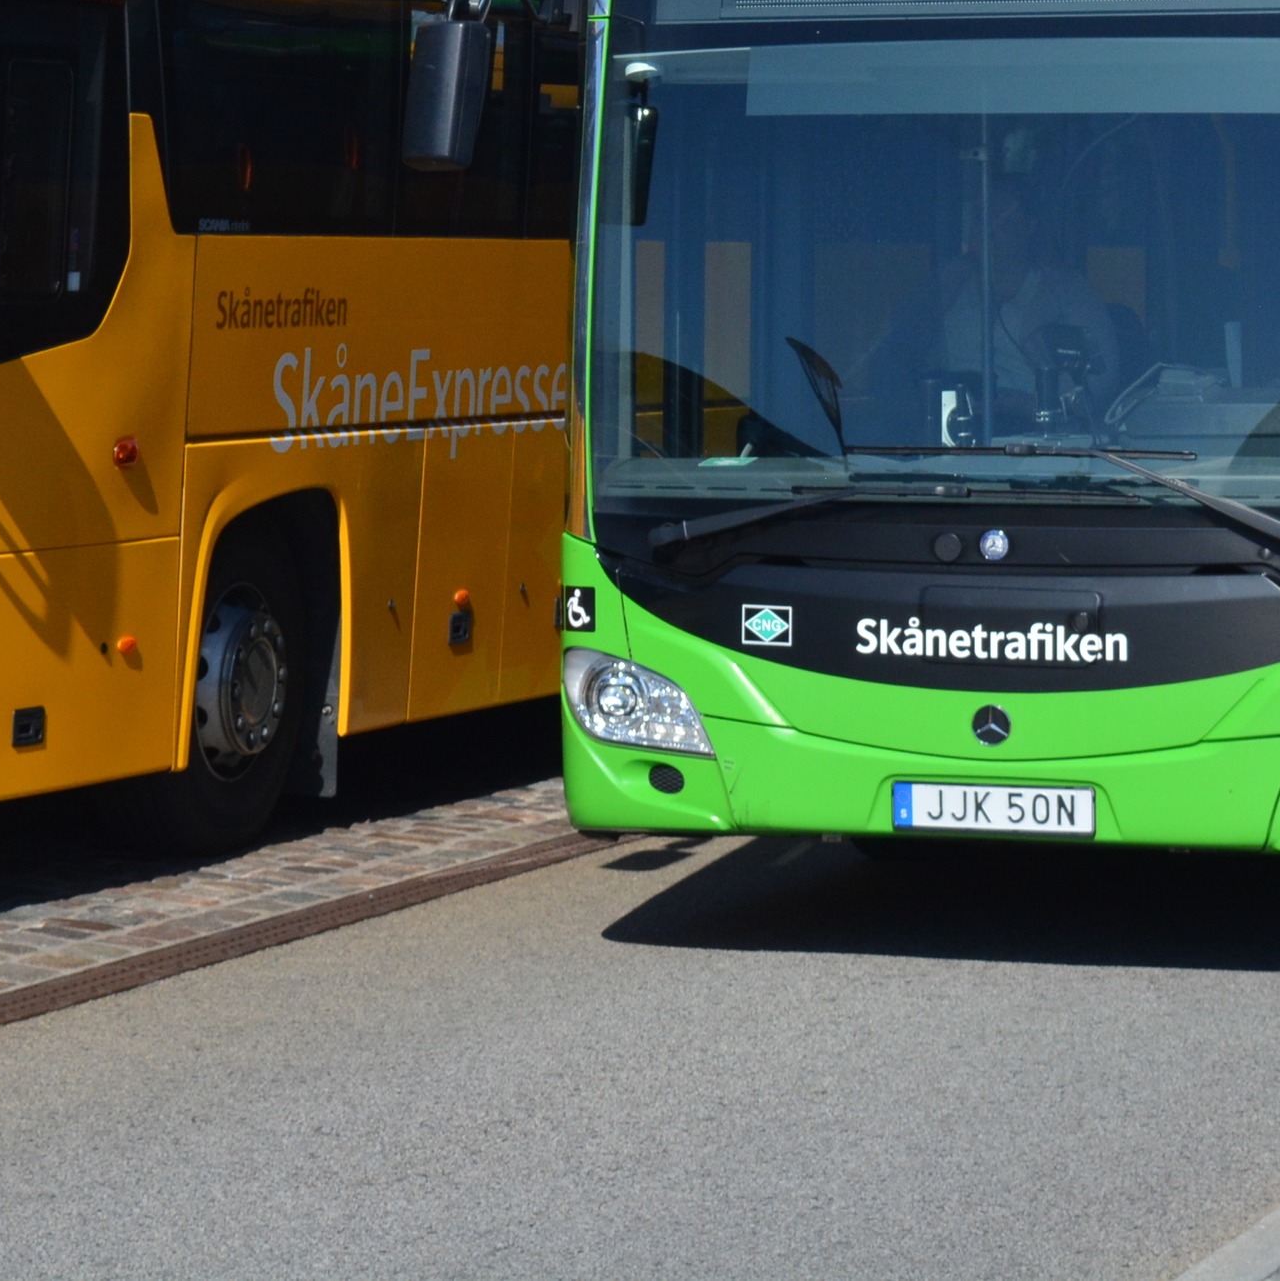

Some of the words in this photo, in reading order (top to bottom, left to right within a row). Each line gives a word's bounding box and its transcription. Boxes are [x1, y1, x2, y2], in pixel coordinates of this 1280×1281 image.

[215, 287, 348, 330] Skånetrafiken
[752, 618, 782, 632] CNG
[855, 616, 1129, 663] Skånetrafiken
[899, 808, 908, 819] S
[926, 789, 992, 824] JJK
[1006, 792, 1076, 827] 50N
